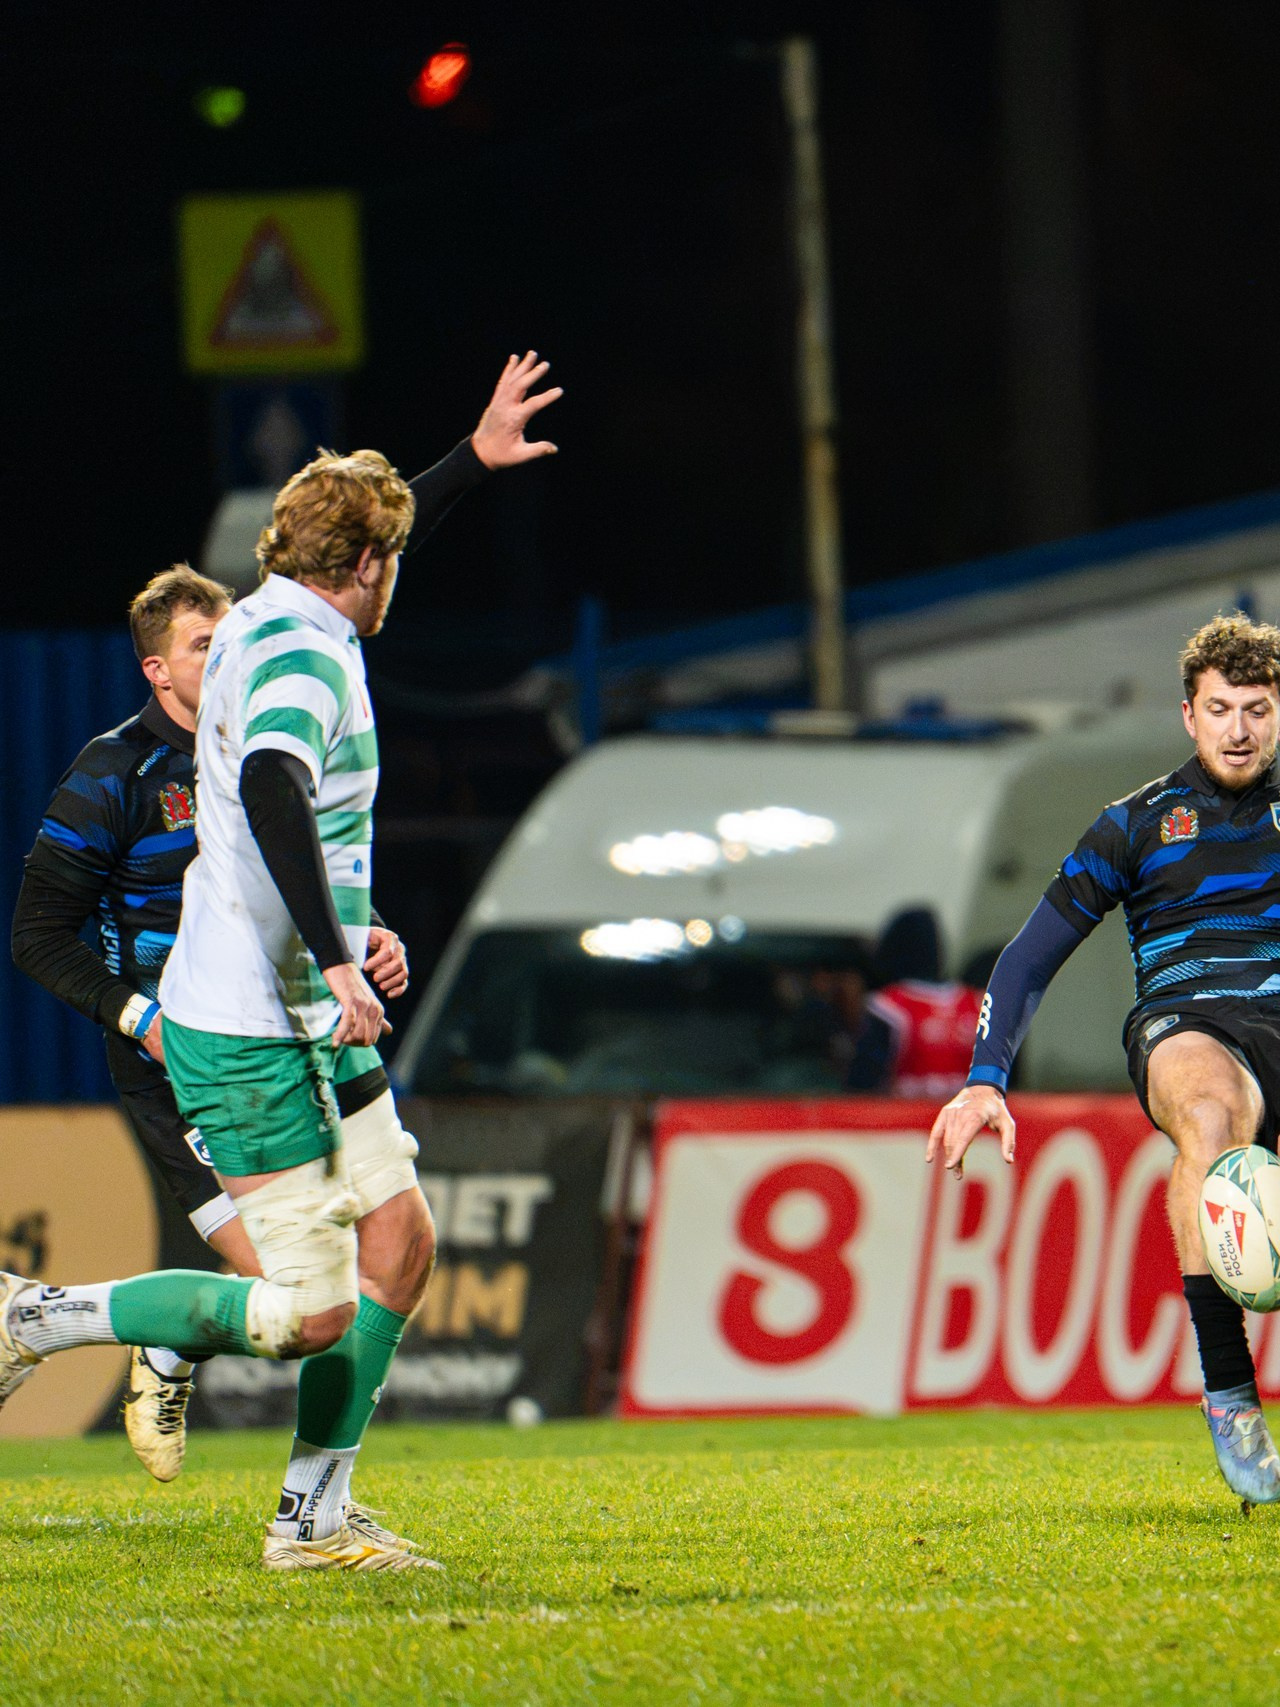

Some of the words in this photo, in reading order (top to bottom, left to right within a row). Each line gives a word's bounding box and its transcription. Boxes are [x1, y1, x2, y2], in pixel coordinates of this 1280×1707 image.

[715, 1158, 861, 1366] 8
[1218, 1243, 1235, 1277] РЕГБИ
[1224, 1231, 1244, 1277] РОССИИ
